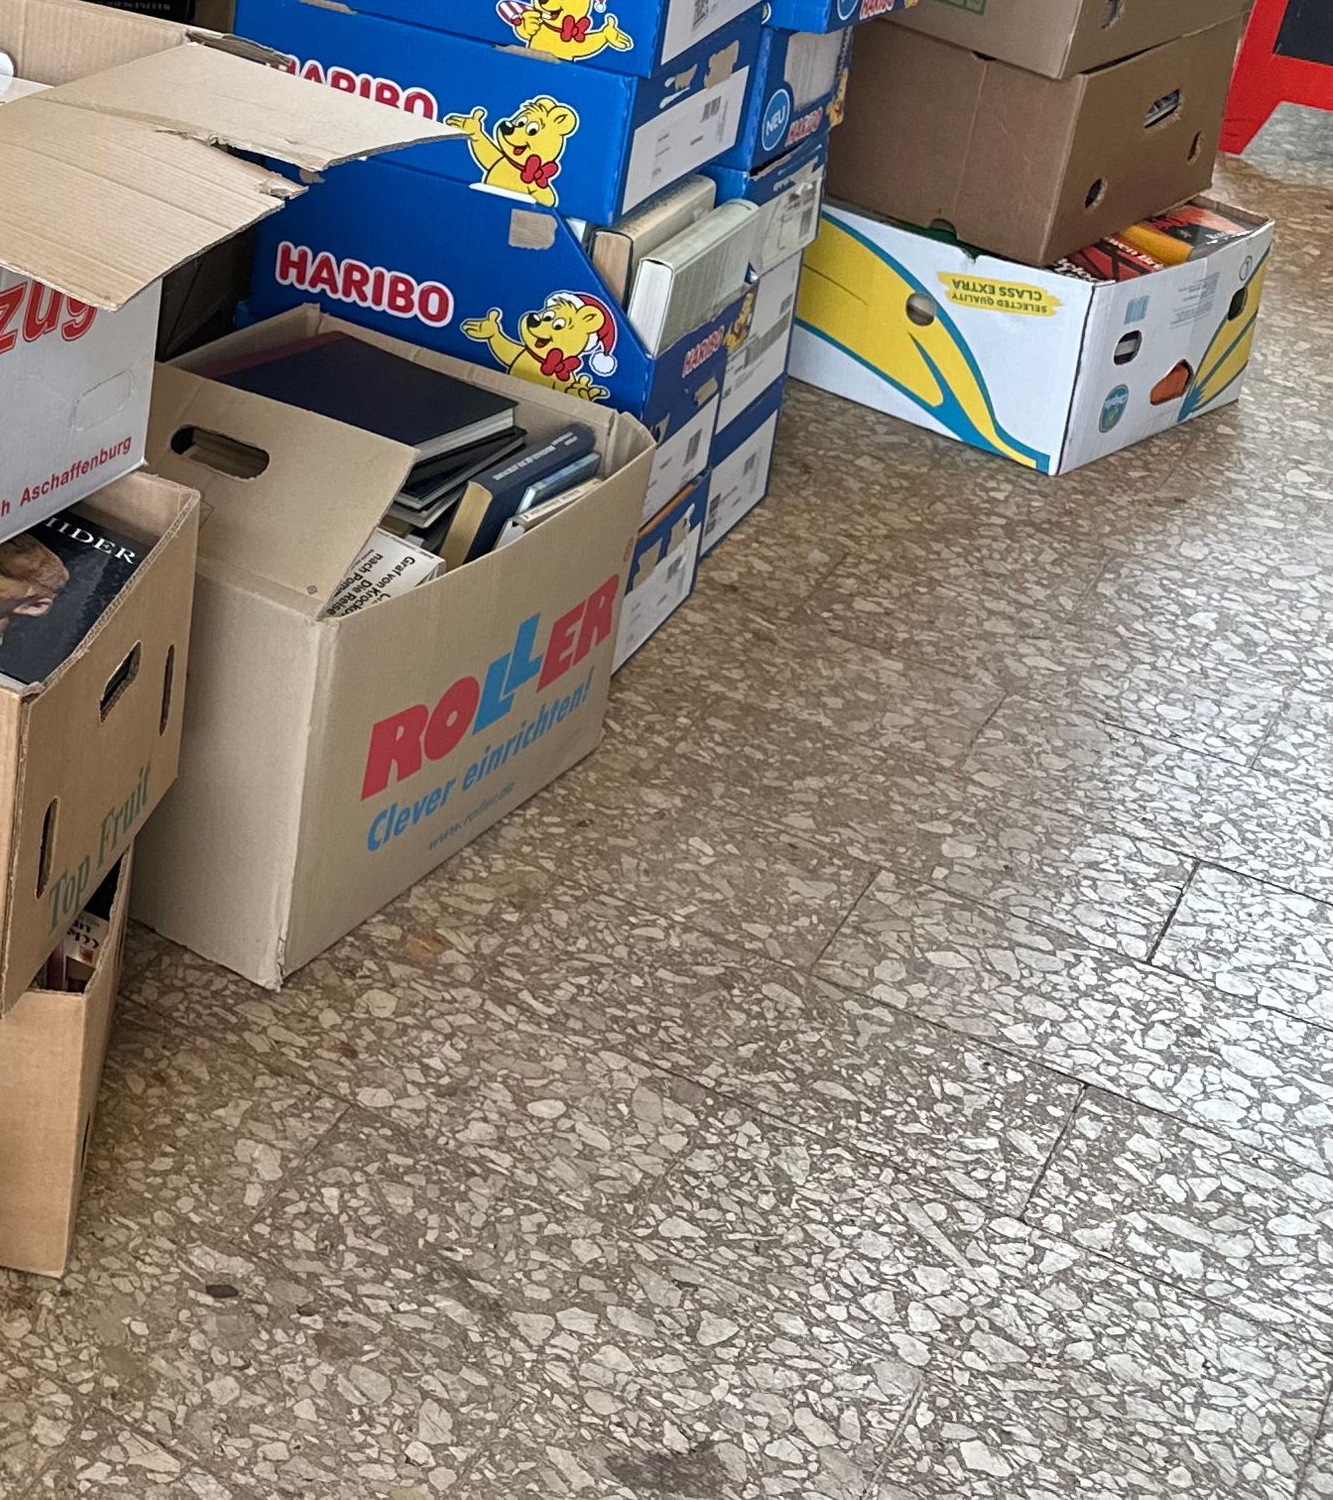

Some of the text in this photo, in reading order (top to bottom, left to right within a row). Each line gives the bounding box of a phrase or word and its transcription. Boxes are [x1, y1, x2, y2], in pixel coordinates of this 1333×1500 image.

[765, 104, 787, 137] NEU
[278, 244, 452, 325] HARIBO
[951, 292, 1048, 314] SELECTED QUALITY
[952, 279, 1043, 302] CLASS EXTRA
[19, 435, 134, 508] Aschaffenburg
[358, 552, 384, 574] nach
[375, 556, 416, 589] Graf von
[326, 579, 373, 616] Die Reise
[361, 573, 620, 802] ROLLER
[366, 667, 595, 853] Clever einrichten!
[48, 854, 91, 936] Top
